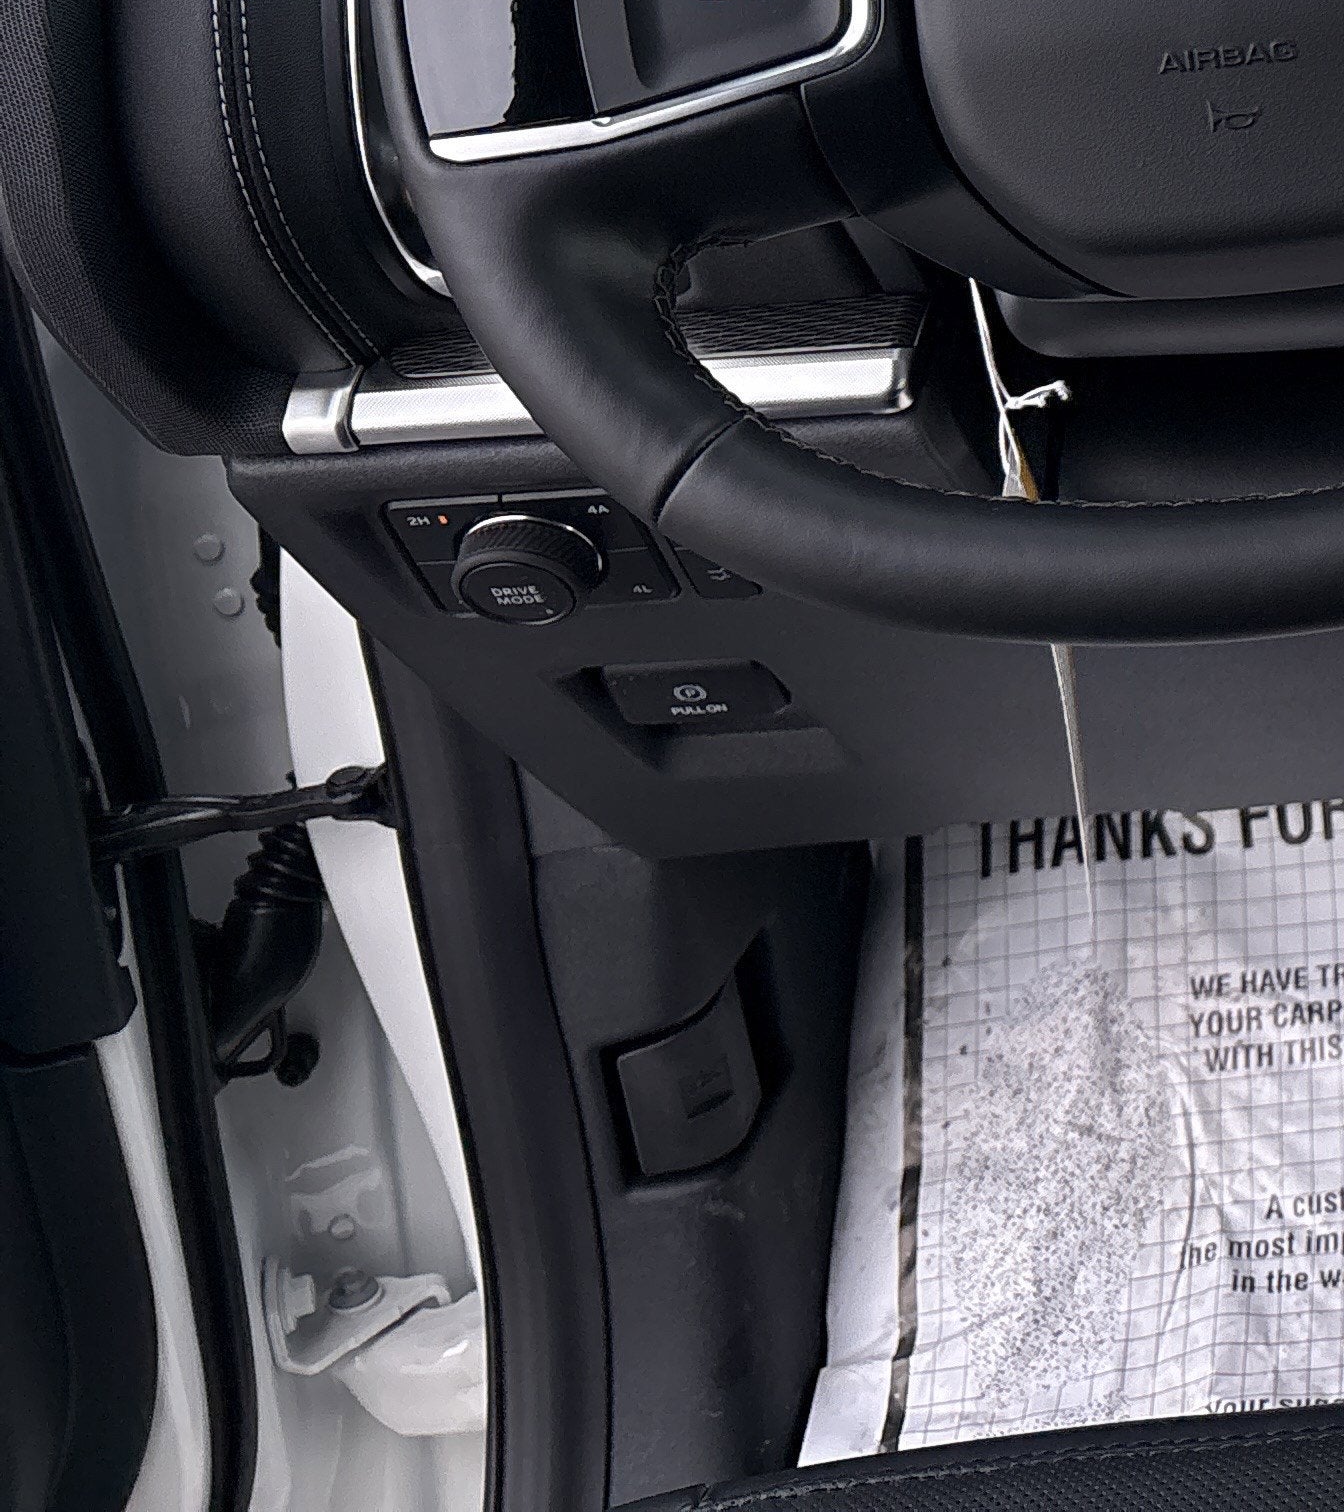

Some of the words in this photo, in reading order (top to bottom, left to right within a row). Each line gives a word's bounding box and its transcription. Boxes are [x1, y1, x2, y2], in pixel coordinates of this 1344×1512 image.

[1158, 38, 1300, 76] AIRBAG
[405, 515, 432, 528] 2H
[586, 503, 611, 516] 4A
[489, 584, 541, 597] DRIVE
[495, 593, 546, 606] MODE
[632, 584, 654, 595] 4L
[669, 703, 703, 717] PULL
[704, 701, 728, 714] ON
[1188, 973, 1233, 999] WE
[1240, 966, 1310, 994] HAVE
[1188, 1005, 1263, 1039] YOUR
[1204, 1040, 1274, 1073] WITH
[1282, 1034, 1342, 1065] THIS
[1264, 1194, 1284, 1221] A
[1227, 1233, 1296, 1260] most
[1230, 1269, 1256, 1294] in
[1266, 1266, 1310, 1293] the
